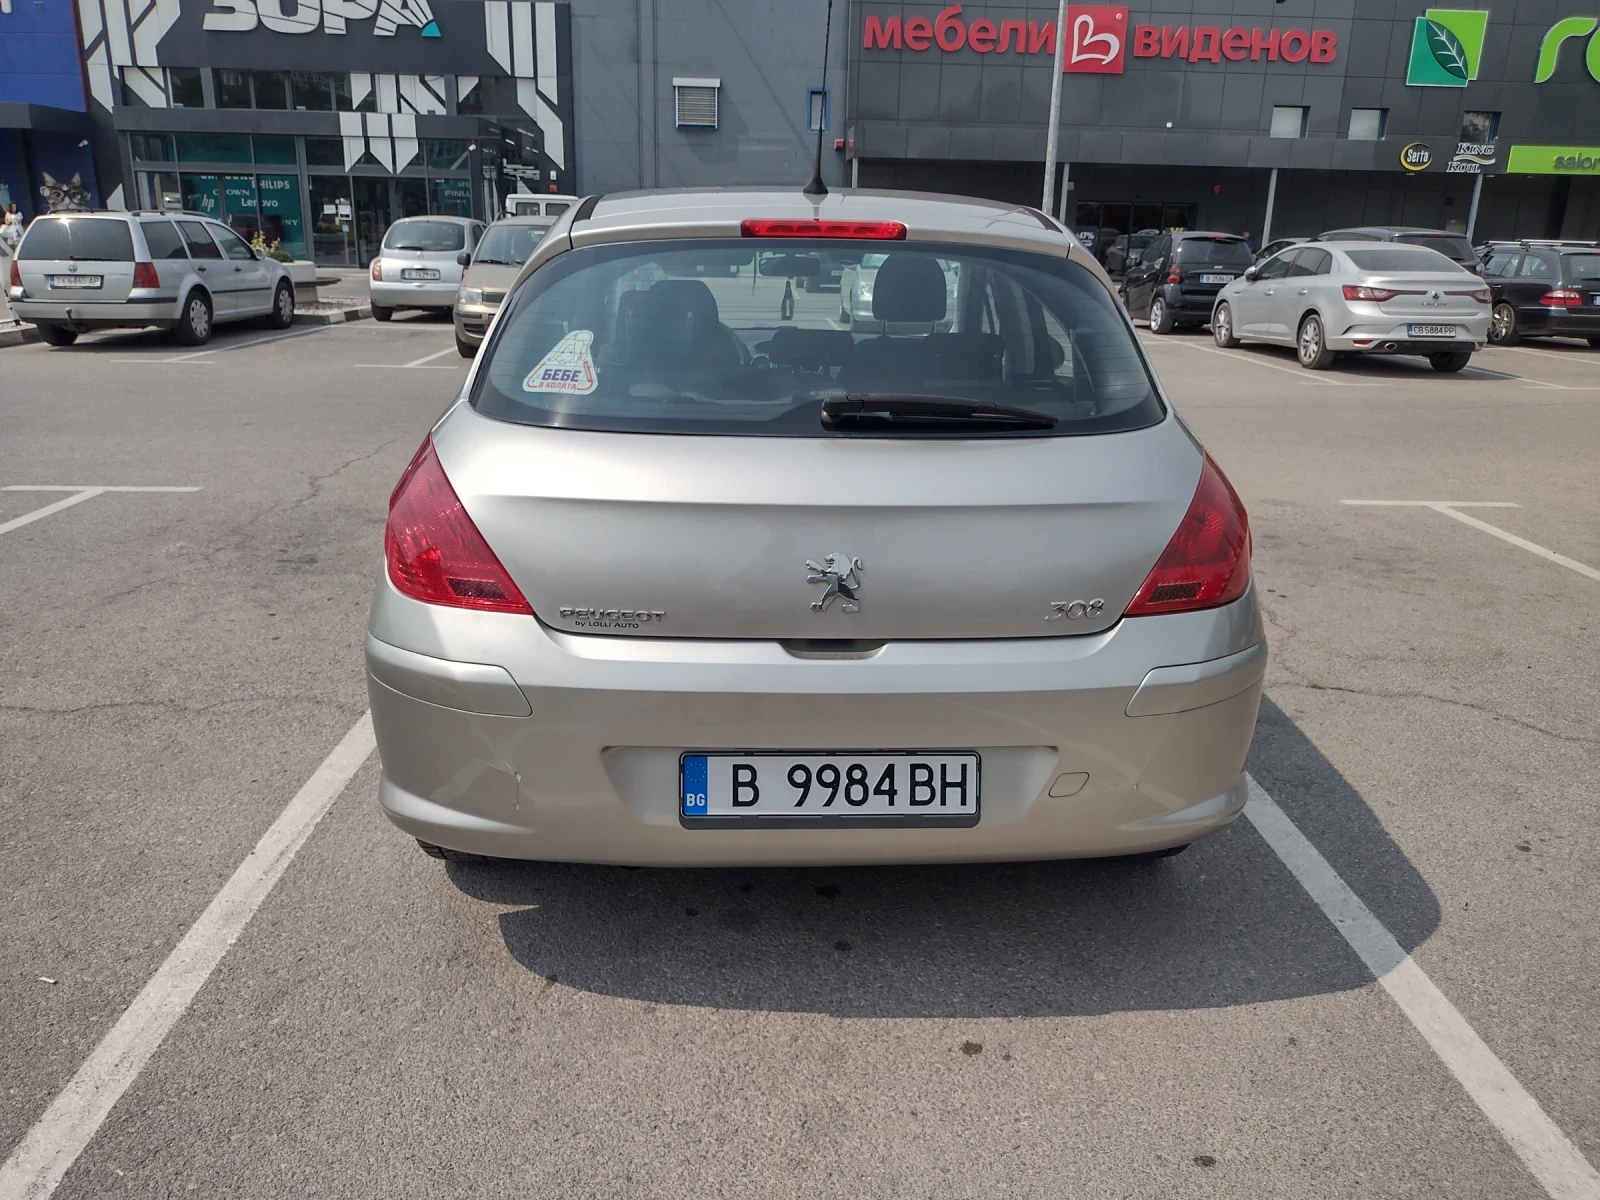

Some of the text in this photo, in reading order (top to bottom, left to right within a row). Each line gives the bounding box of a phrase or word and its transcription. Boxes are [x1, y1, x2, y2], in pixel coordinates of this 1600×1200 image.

[863, 5, 1337, 64] мебели виденов
[1407, 149, 1429, 163] Serta
[202, 194, 215, 212] hp
[541, 368, 582, 382] БЕБЕ
[545, 382, 577, 390] КОЛАТА
[560, 607, 666, 622] PEUGEOT
[1045, 598, 1105, 621] 308
[732, 763, 968, 807] B 9984 BH
[686, 793, 706, 807] BG
